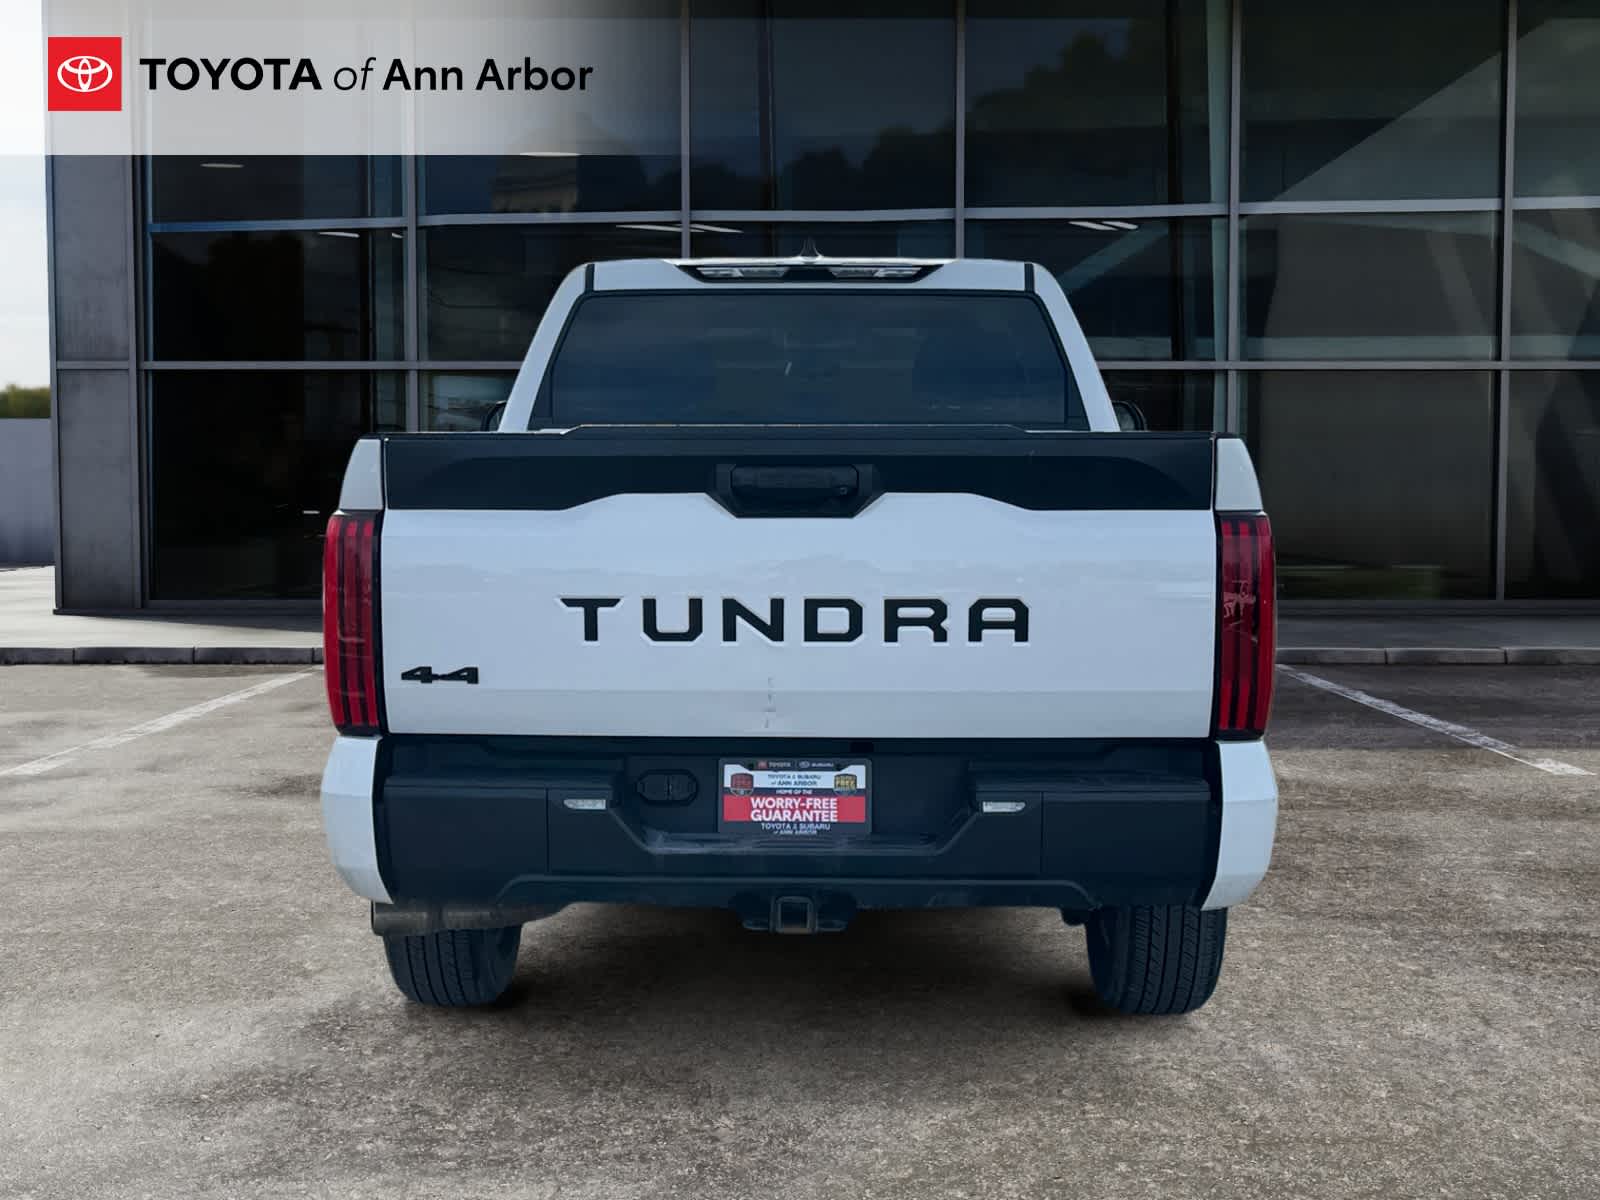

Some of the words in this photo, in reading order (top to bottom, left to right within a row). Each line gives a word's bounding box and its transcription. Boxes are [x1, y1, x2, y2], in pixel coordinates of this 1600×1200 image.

[557, 597, 1031, 645] TUNDRA
[751, 797, 837, 809] WORRY-FREE
[751, 809, 838, 822] GUARANTEE
[799, 823, 831, 831] SUBARU
